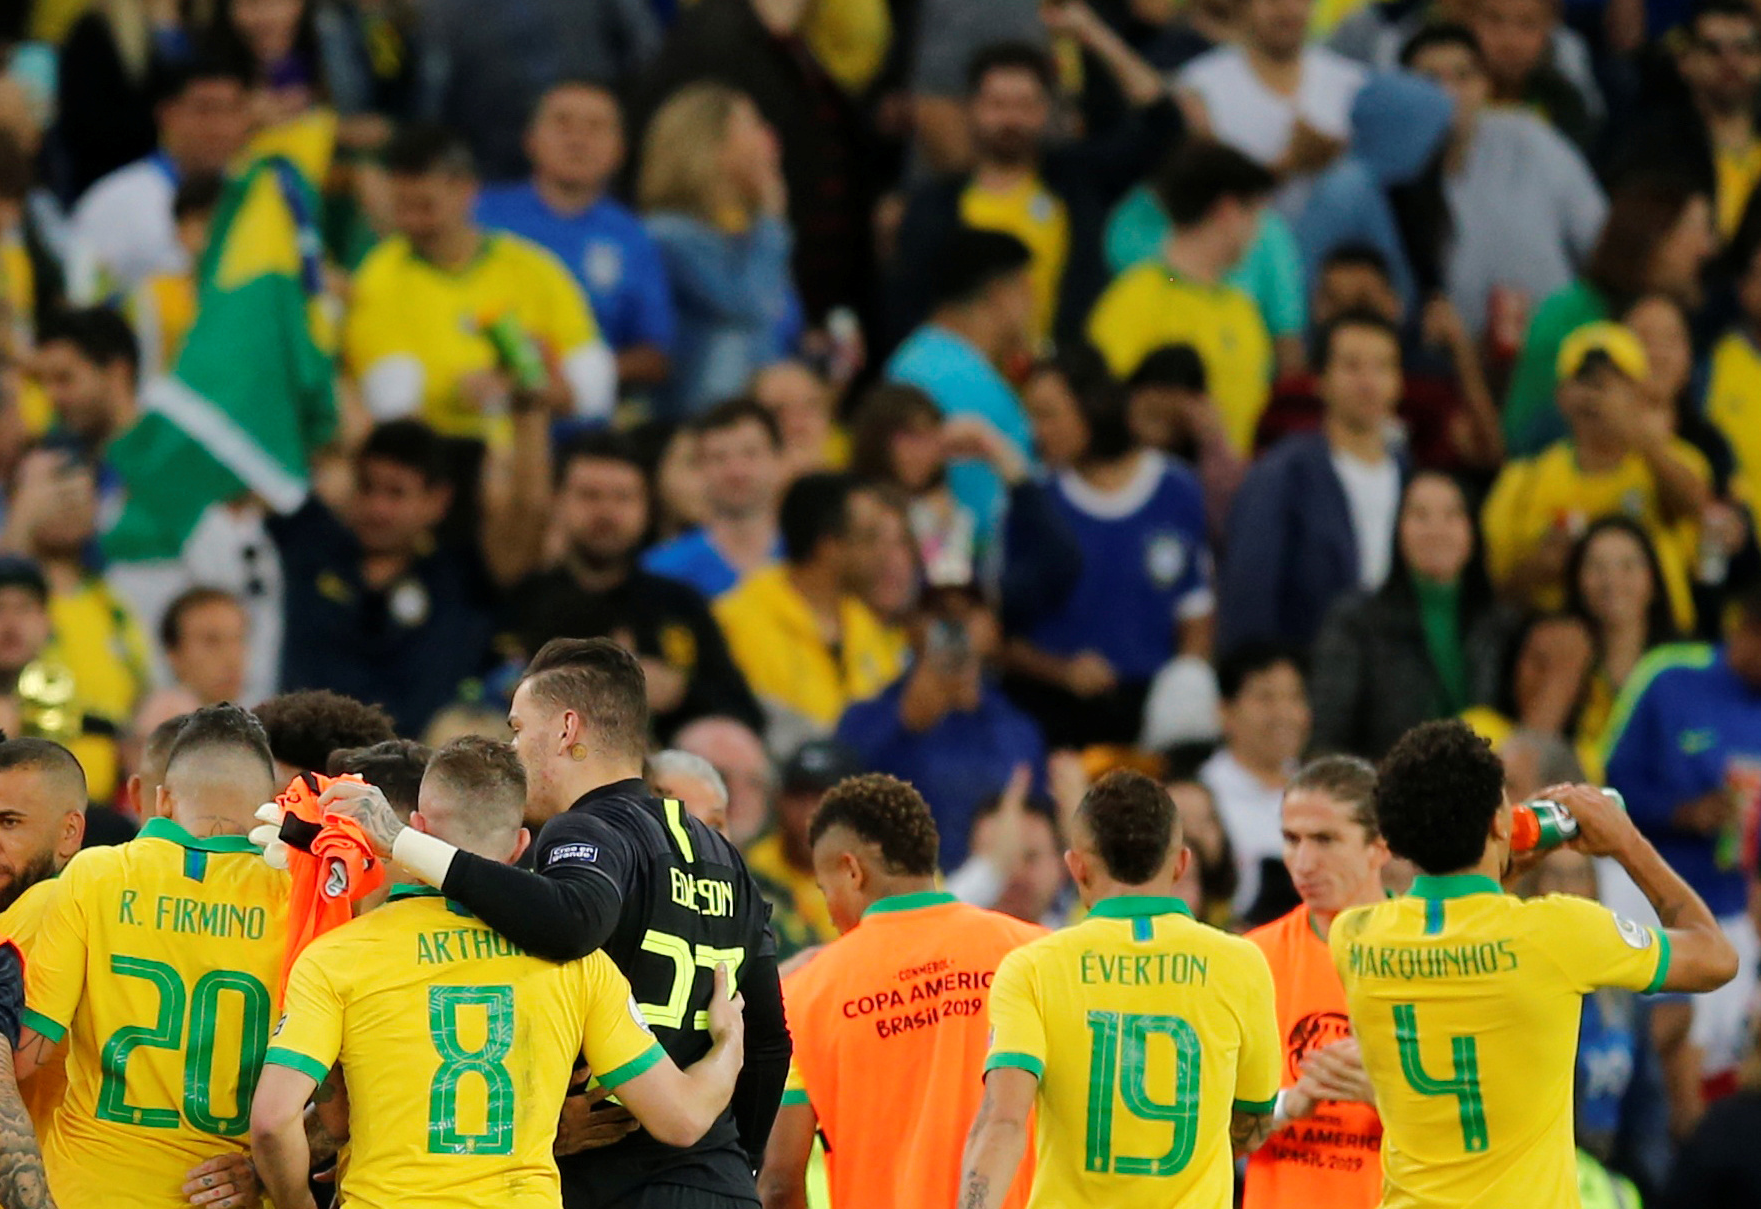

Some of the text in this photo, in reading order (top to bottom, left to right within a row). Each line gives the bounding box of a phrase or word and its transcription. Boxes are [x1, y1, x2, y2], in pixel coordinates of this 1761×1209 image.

[119, 889, 266, 941] R. FIRMINO
[417, 928, 524, 965] ARTHU
[1080, 950, 1208, 988] ÉVERTON
[1348, 938, 1519, 981] MARQUINHOS
[842, 971, 996, 1019] COPA AMERIC
[942, 997, 983, 1017] 2019
[95, 953, 272, 1137] 20
[427, 984, 515, 1156] 8
[1085, 1009, 1203, 1178] 19
[1391, 1003, 1490, 1154] 4
[1328, 1154, 1363, 1173] 2019
